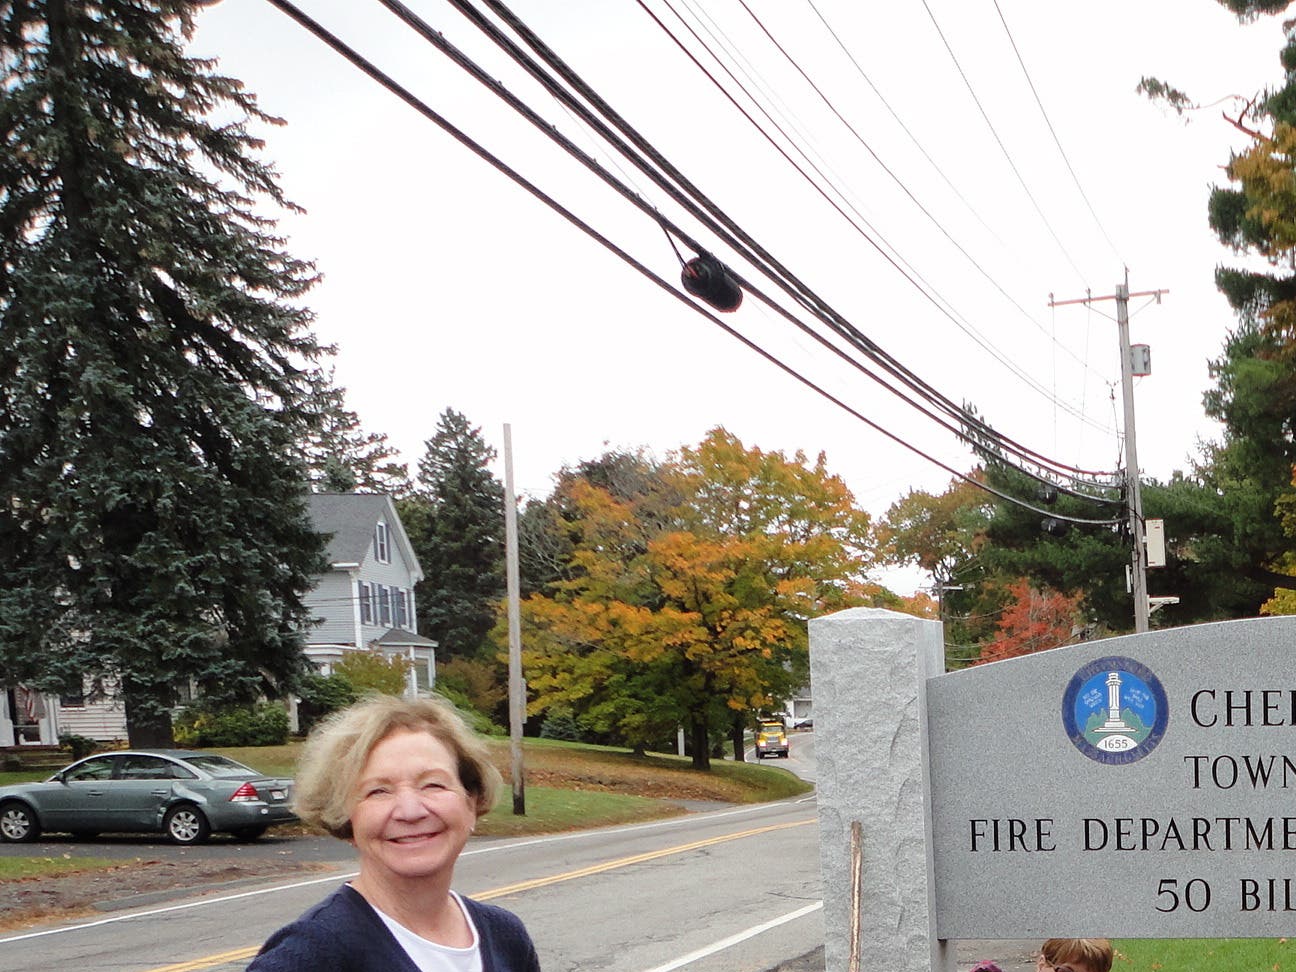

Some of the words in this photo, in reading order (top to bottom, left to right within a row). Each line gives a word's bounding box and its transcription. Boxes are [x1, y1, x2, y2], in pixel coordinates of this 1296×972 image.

[1103, 738, 1129, 750] 1655
[969, 818, 1057, 853] FIRE
[1155, 878, 1212, 914] 50
